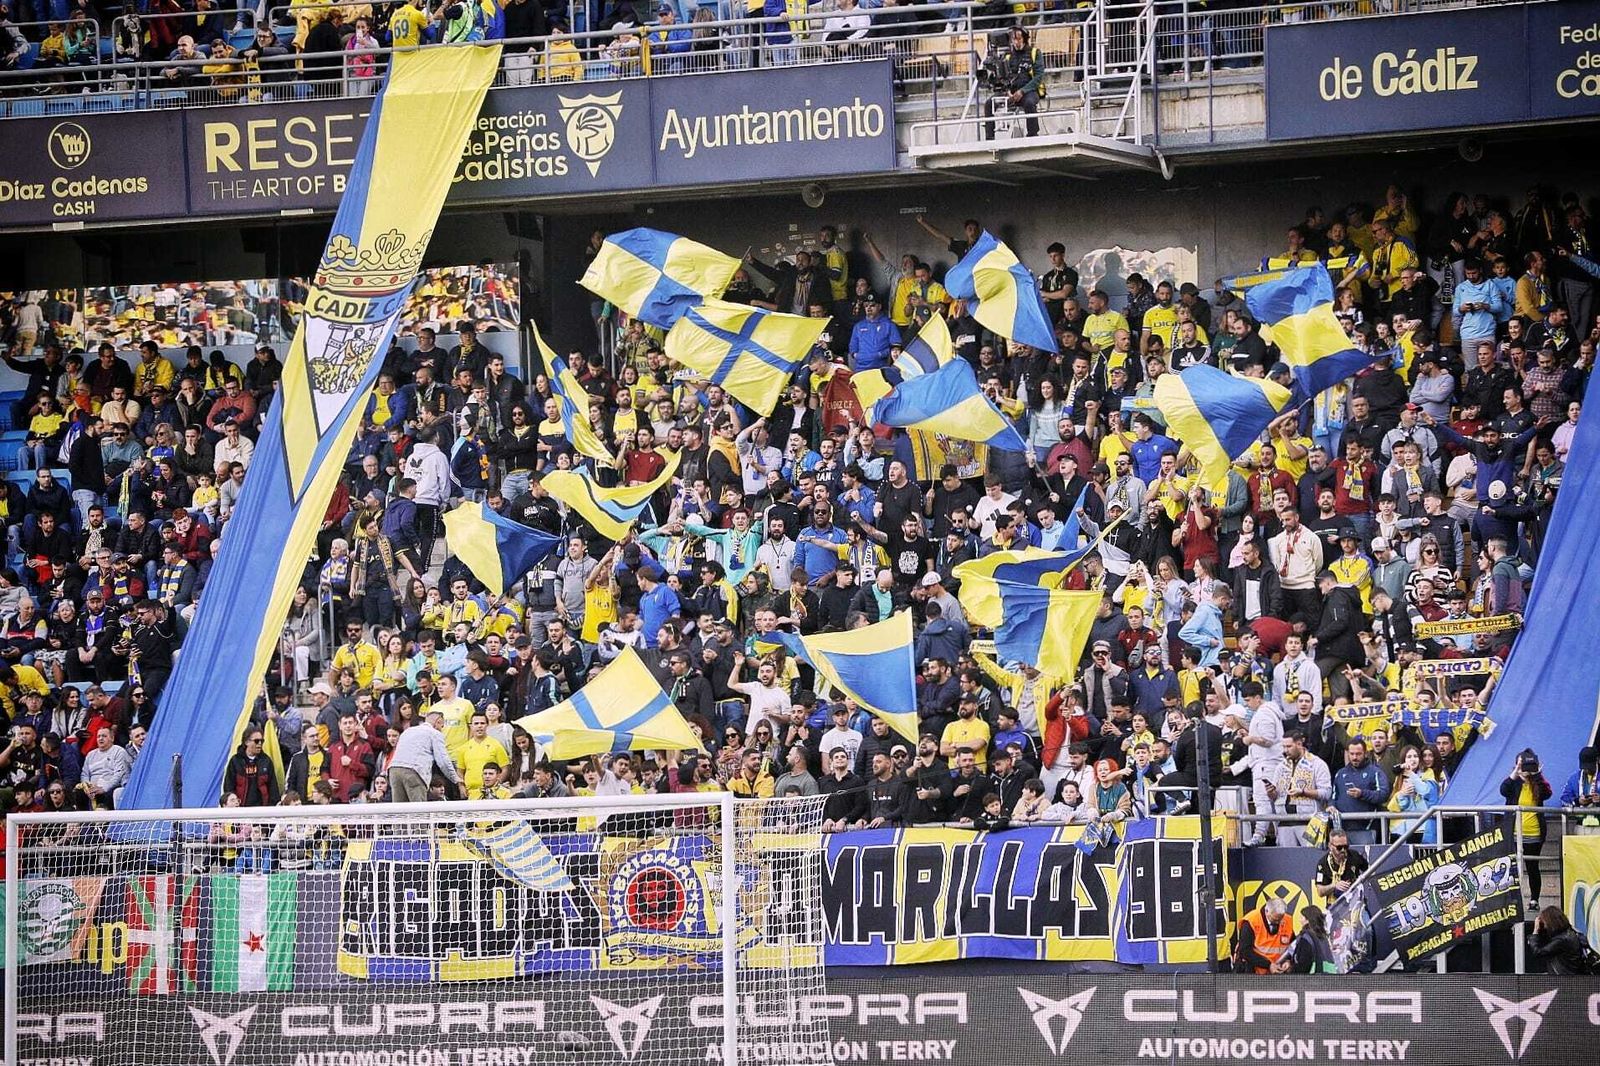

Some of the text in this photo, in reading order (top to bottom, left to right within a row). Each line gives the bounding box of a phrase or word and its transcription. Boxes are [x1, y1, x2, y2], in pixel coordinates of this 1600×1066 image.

[394, 19, 409, 39] 69
[1319, 47, 1478, 100] de Cádiz
[472, 110, 547, 132] eración
[660, 97, 884, 158] Ayuntamiento
[204, 113, 371, 173] RESE
[484, 129, 561, 155] Peñas
[0, 175, 148, 201] Díaz Cadenas
[207, 180, 247, 200] THE
[251, 177, 293, 198] ART
[296, 175, 325, 195] OF
[53, 201, 95, 216] CASH
[313, 294, 379, 320] CADIZ
[1338, 703, 1384, 719] CADIZ
[1378, 828, 1504, 892] SECCIÓN LA JANDA
[764, 840, 1117, 946] AMARILLAS
[281, 1000, 544, 1036] CUPRA
[690, 992, 968, 1028] CUPRA
[1123, 989, 1422, 1024] CUPRA
[878, 1040, 957, 1060] TERRY
[1138, 1035, 1410, 1060] AUTOMOCIÓN TERRY
